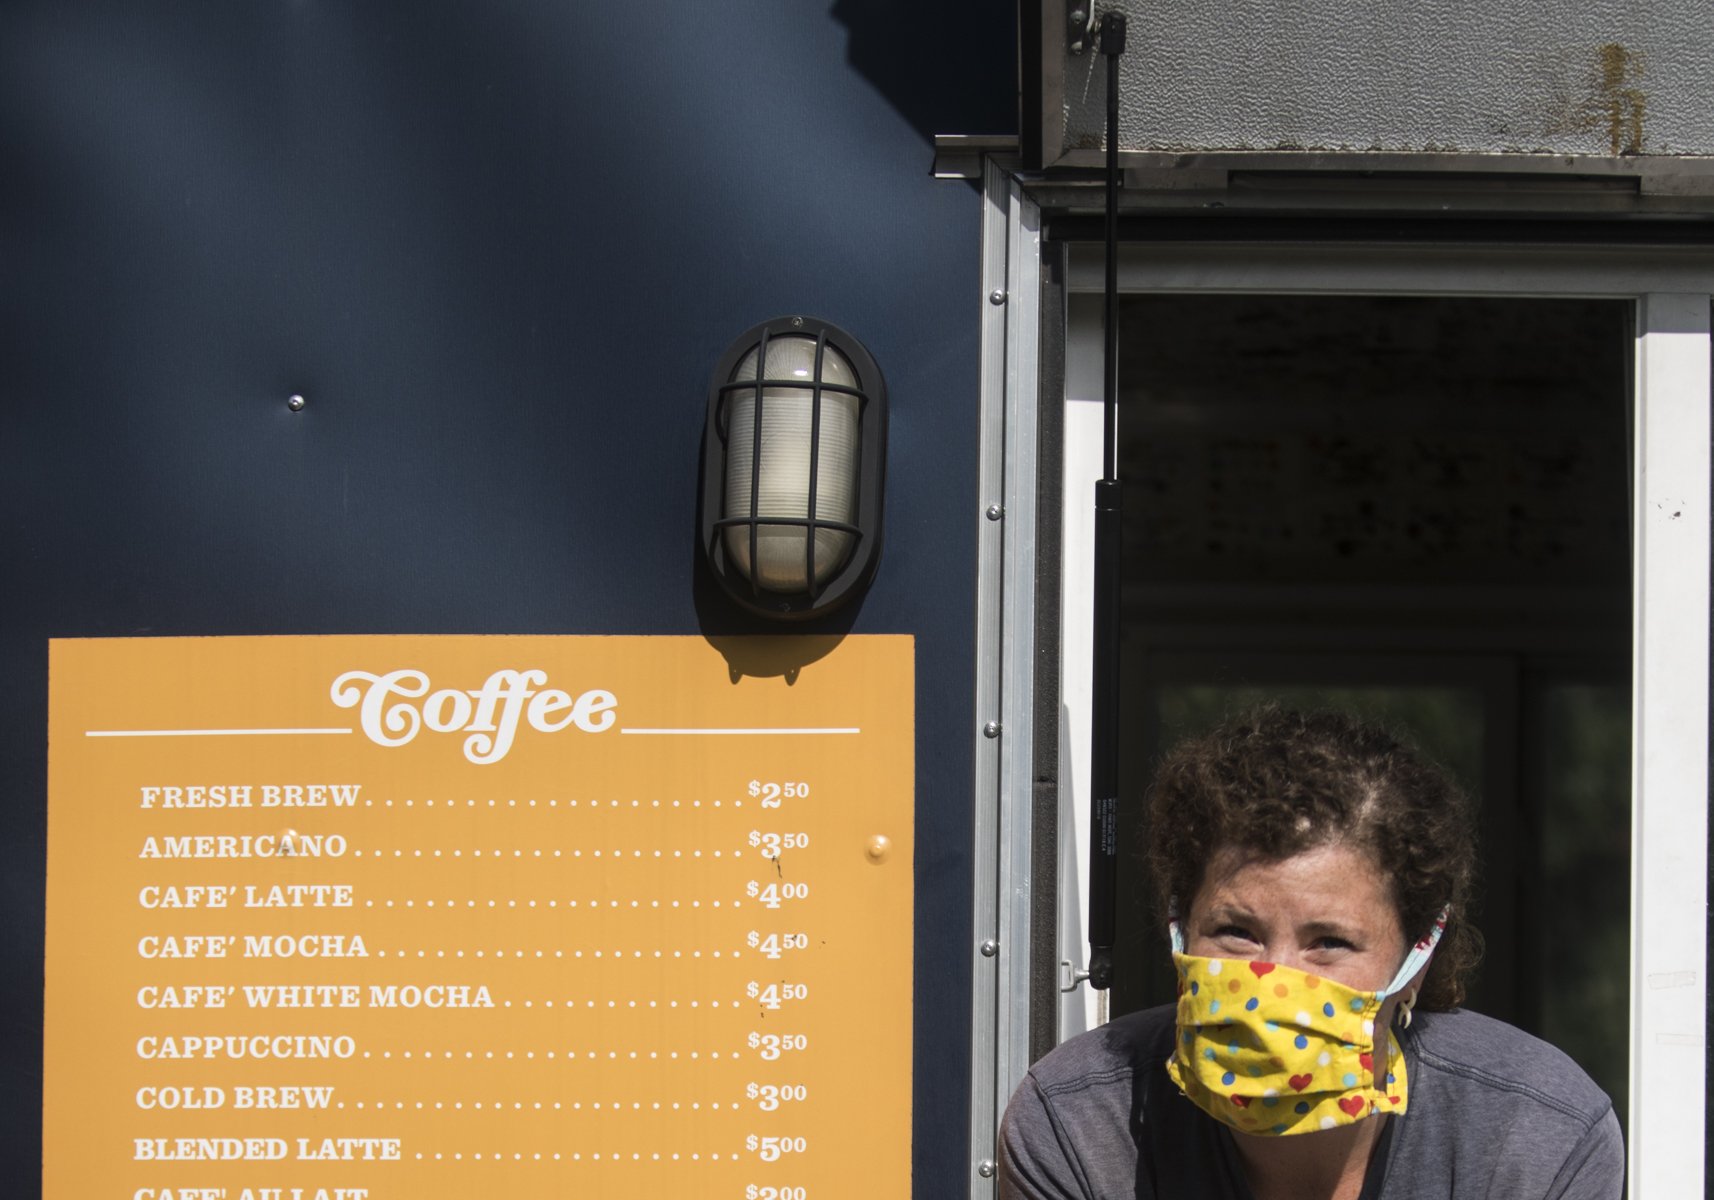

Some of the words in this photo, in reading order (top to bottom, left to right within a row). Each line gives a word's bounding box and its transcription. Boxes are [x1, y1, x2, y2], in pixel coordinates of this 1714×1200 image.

[329, 668, 619, 765] Coffee
[140, 784, 253, 809] FRESH
[260, 784, 362, 808] BREW
[138, 832, 347, 859] AMERICANO
[243, 884, 353, 908] LATTE
[243, 934, 370, 958] MOCHA
[241, 984, 361, 1009] WHITE
[368, 984, 496, 1009] MOCHA
[135, 1035, 356, 1060] CAPPUCCINO
[135, 1086, 226, 1110] COLD
[233, 1086, 335, 1110] BREW
[133, 1137, 288, 1161] BLENDED
[296, 1137, 401, 1161] LATTE
